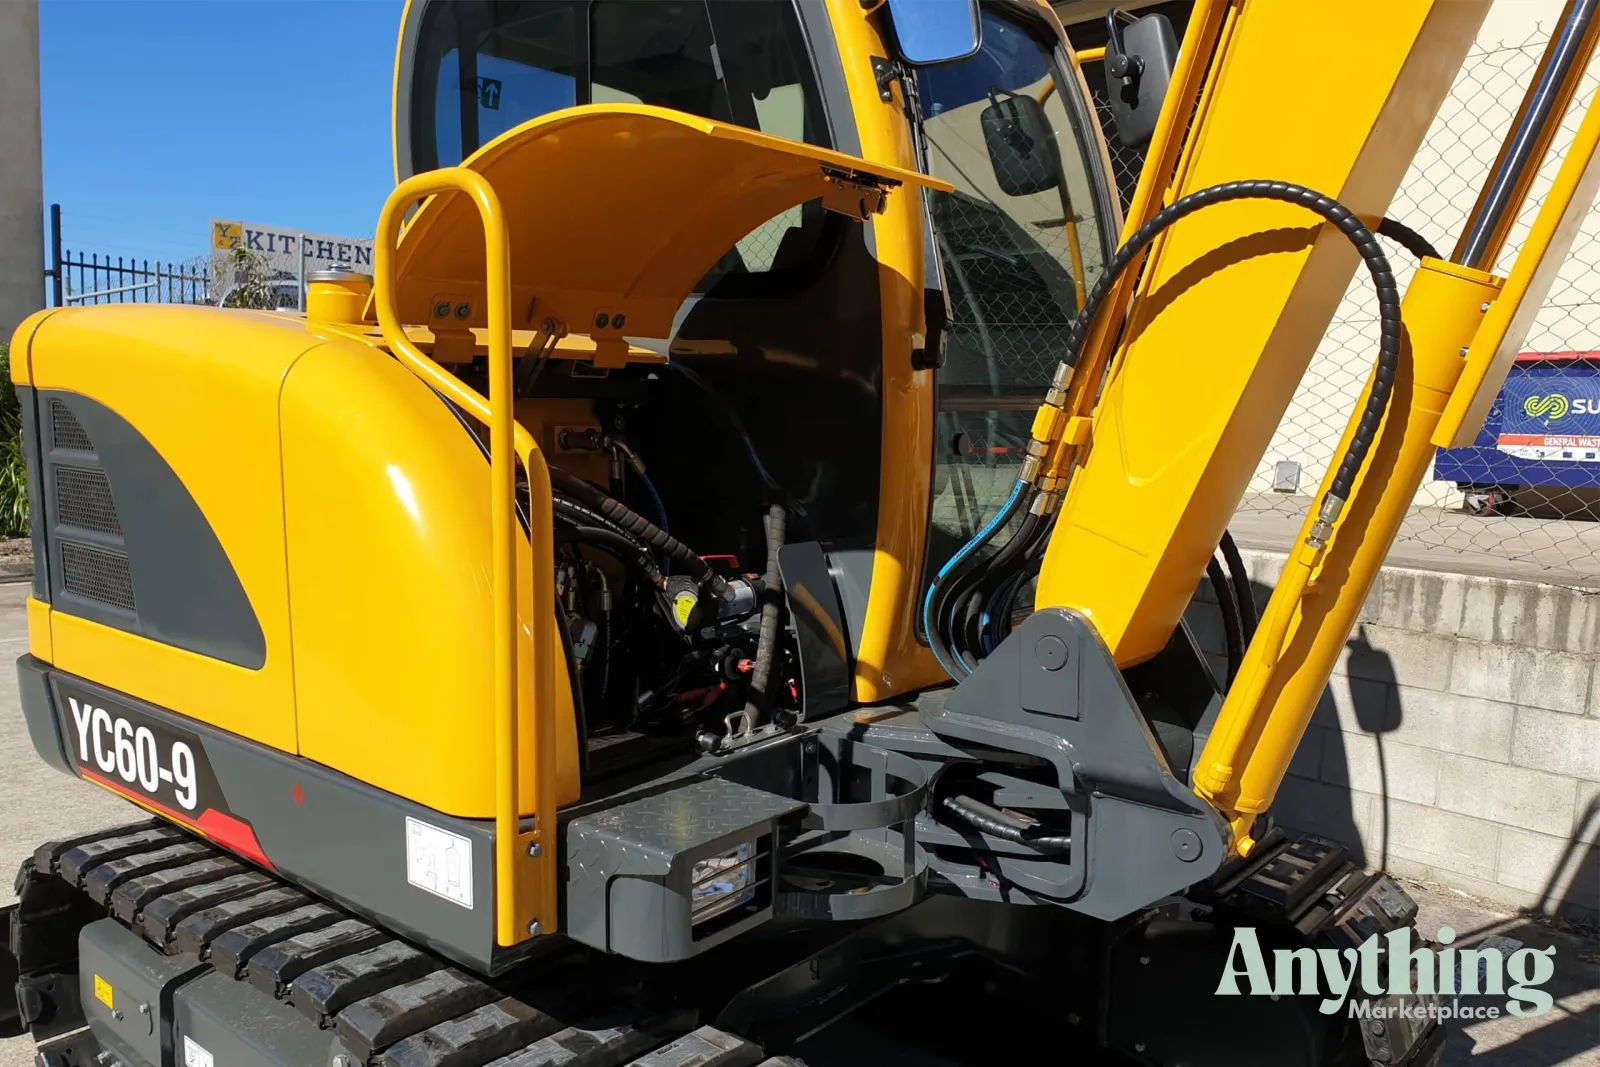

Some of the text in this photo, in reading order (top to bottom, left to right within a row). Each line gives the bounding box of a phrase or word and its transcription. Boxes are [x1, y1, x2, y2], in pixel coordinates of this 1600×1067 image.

[245, 229, 372, 264] KITCHEN
[1571, 398, 1600, 414] SU
[1544, 437, 1577, 447] GENERAL
[68, 697, 197, 810] YC60-9
